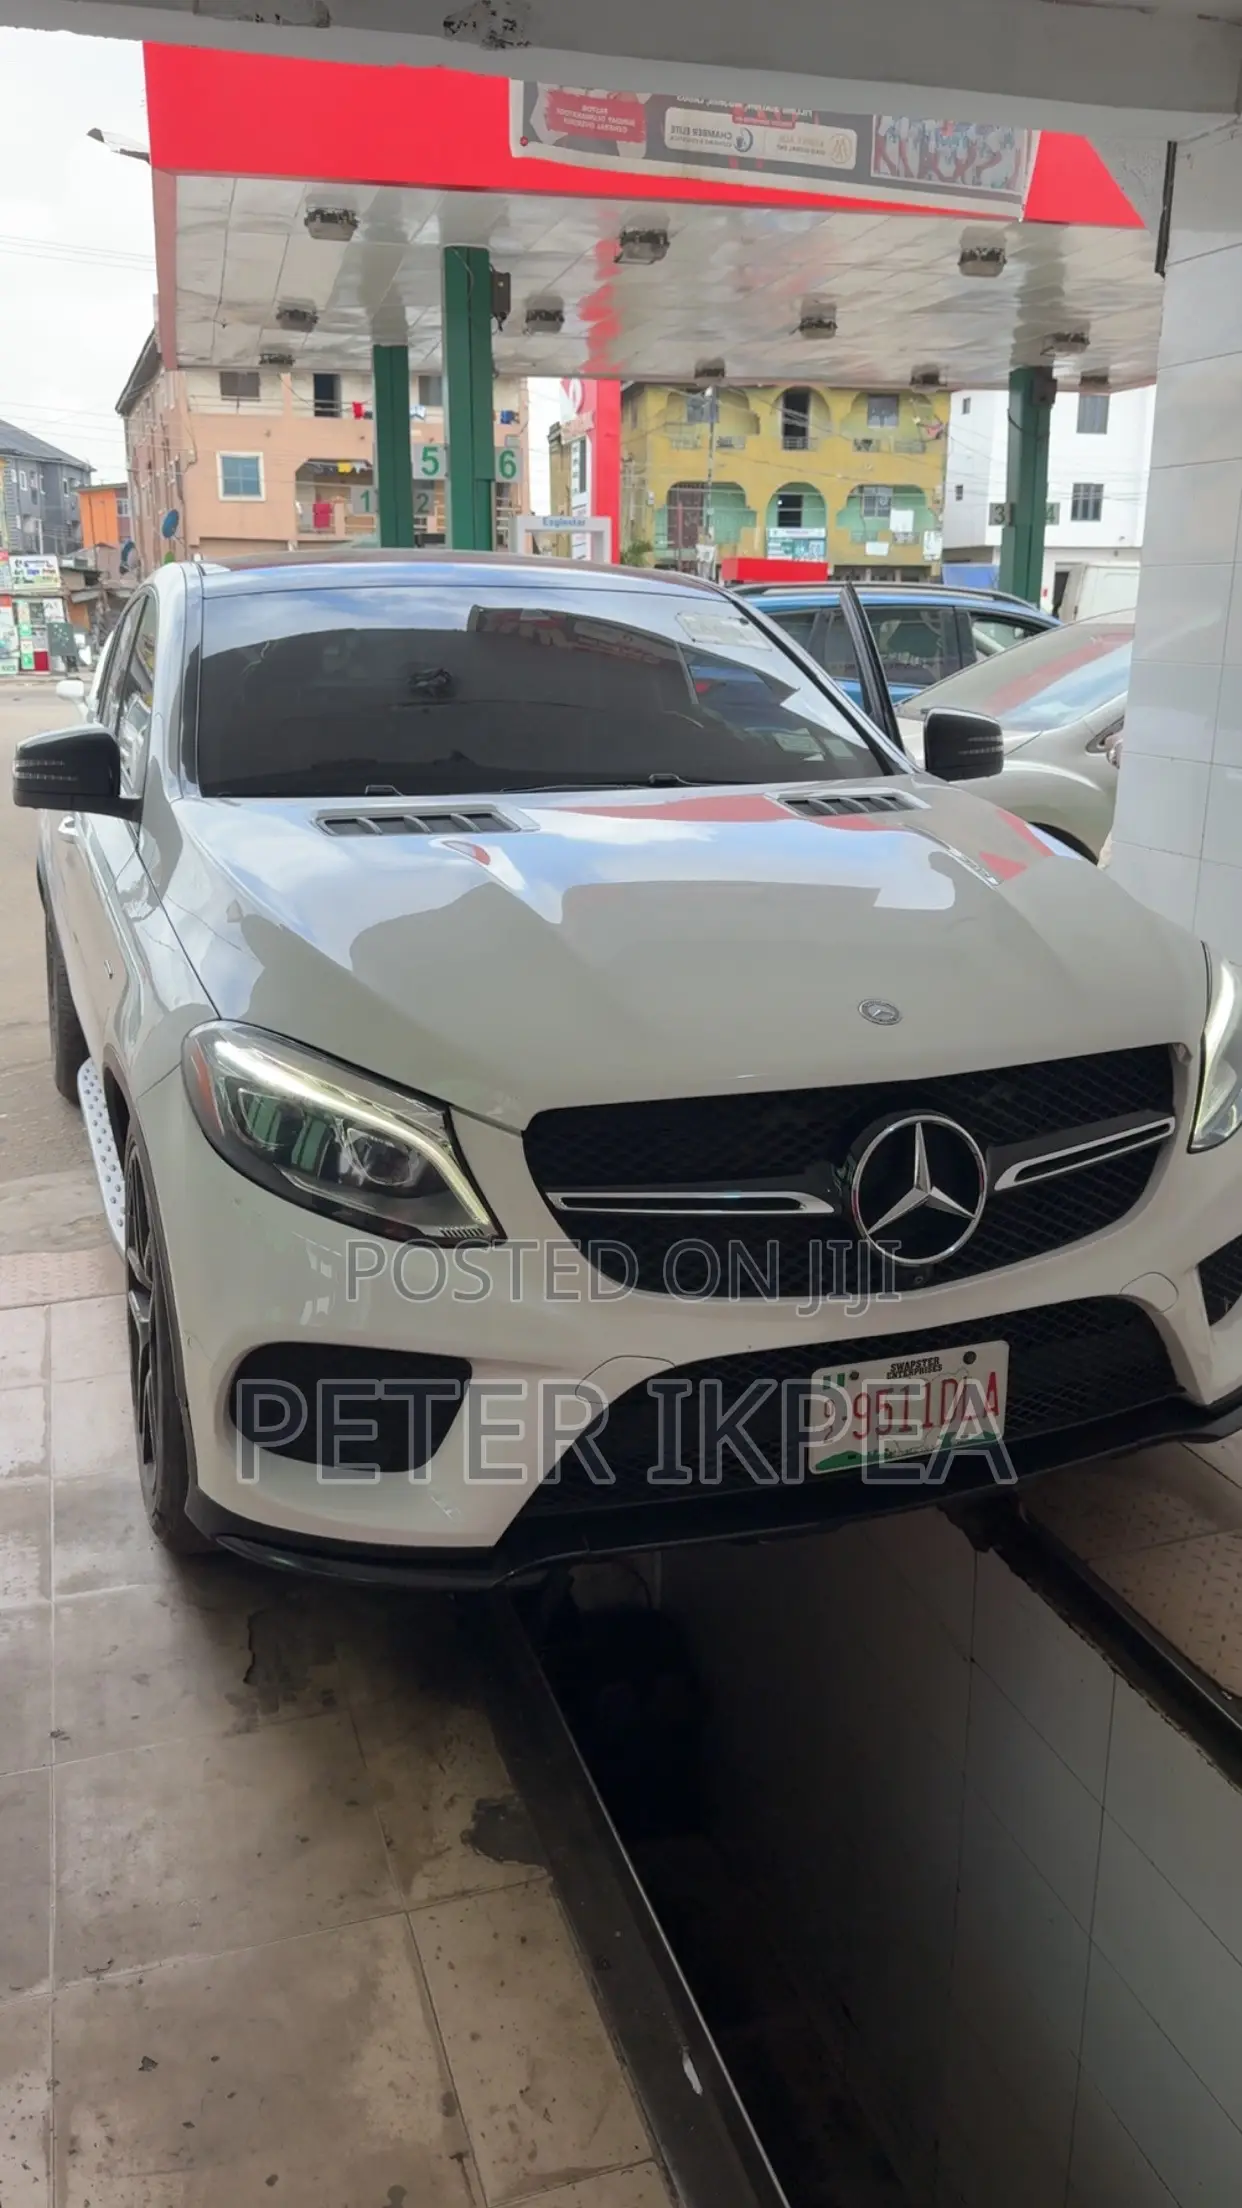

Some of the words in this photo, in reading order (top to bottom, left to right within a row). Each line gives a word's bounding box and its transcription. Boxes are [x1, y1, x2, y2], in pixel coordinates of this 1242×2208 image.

[421, 446, 440, 477] 5
[499, 450, 517, 479] 6
[360, 490, 370, 513] 1
[415, 492, 430, 513] 2
[994, 504, 1006, 524] 3
[886, 1364, 943, 1380] ENTERPRISES
[890, 1356, 940, 1372] SWAPSTER
